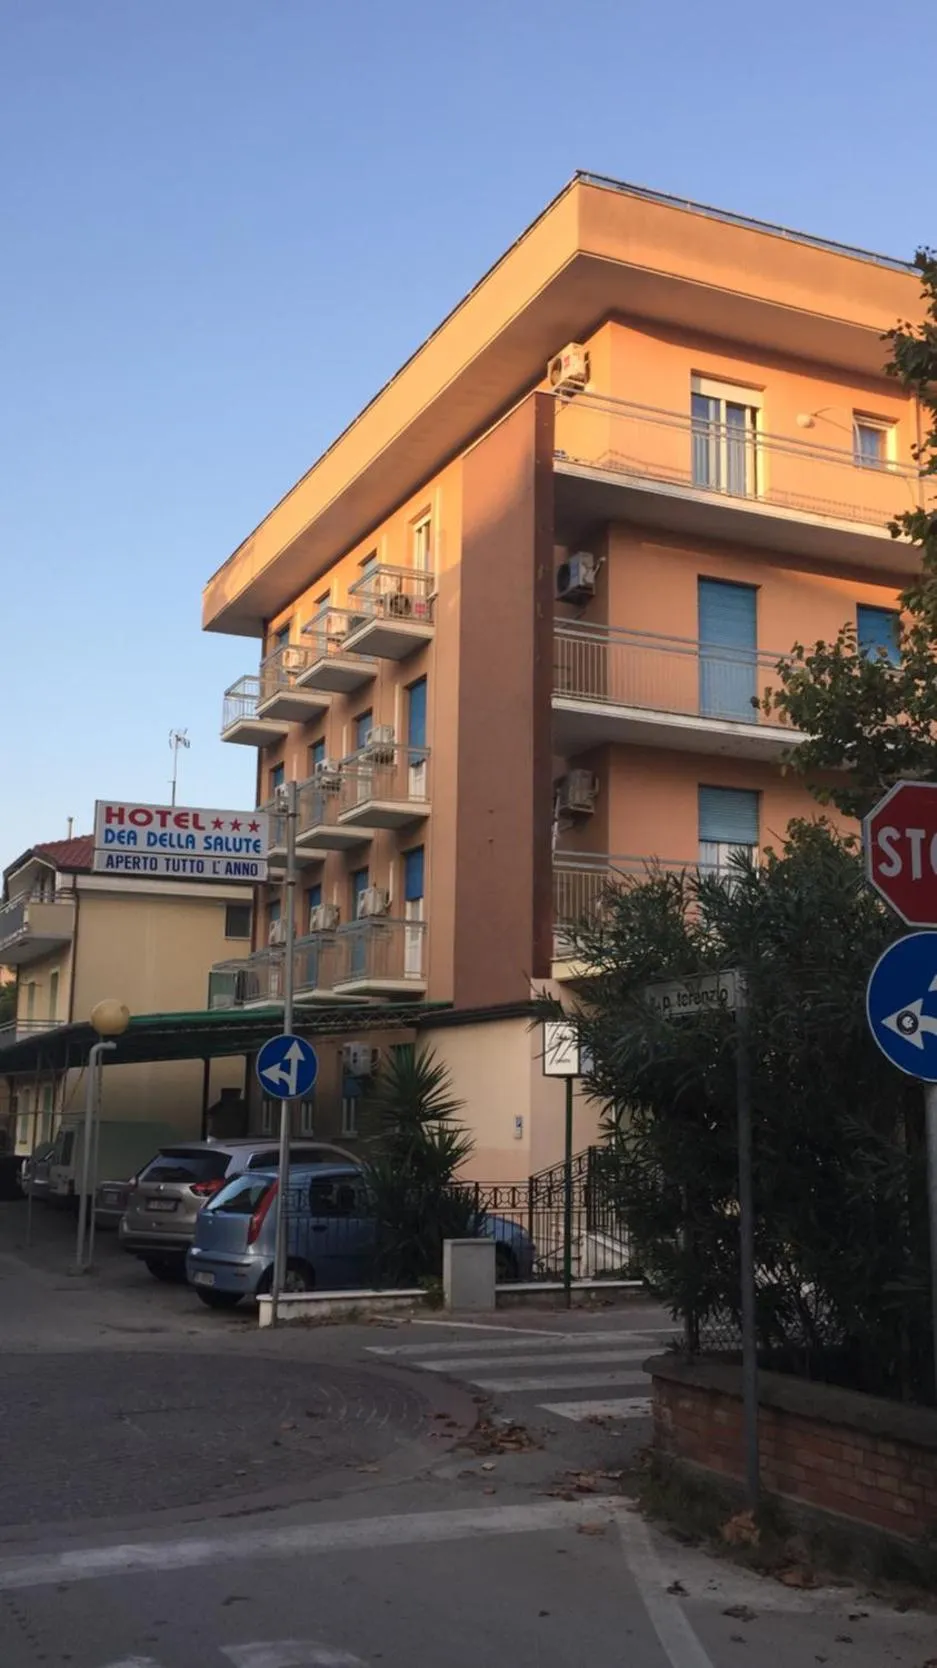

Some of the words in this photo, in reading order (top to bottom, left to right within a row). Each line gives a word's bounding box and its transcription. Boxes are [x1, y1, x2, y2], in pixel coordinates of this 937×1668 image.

[105, 806, 205, 830] HOTEL
[104, 829, 137, 845] DEA
[146, 832, 195, 849] DELLA
[203, 836, 262, 853] SALUTE
[106, 855, 157, 871] APERTO
[165, 858, 204, 873] TUTTO
